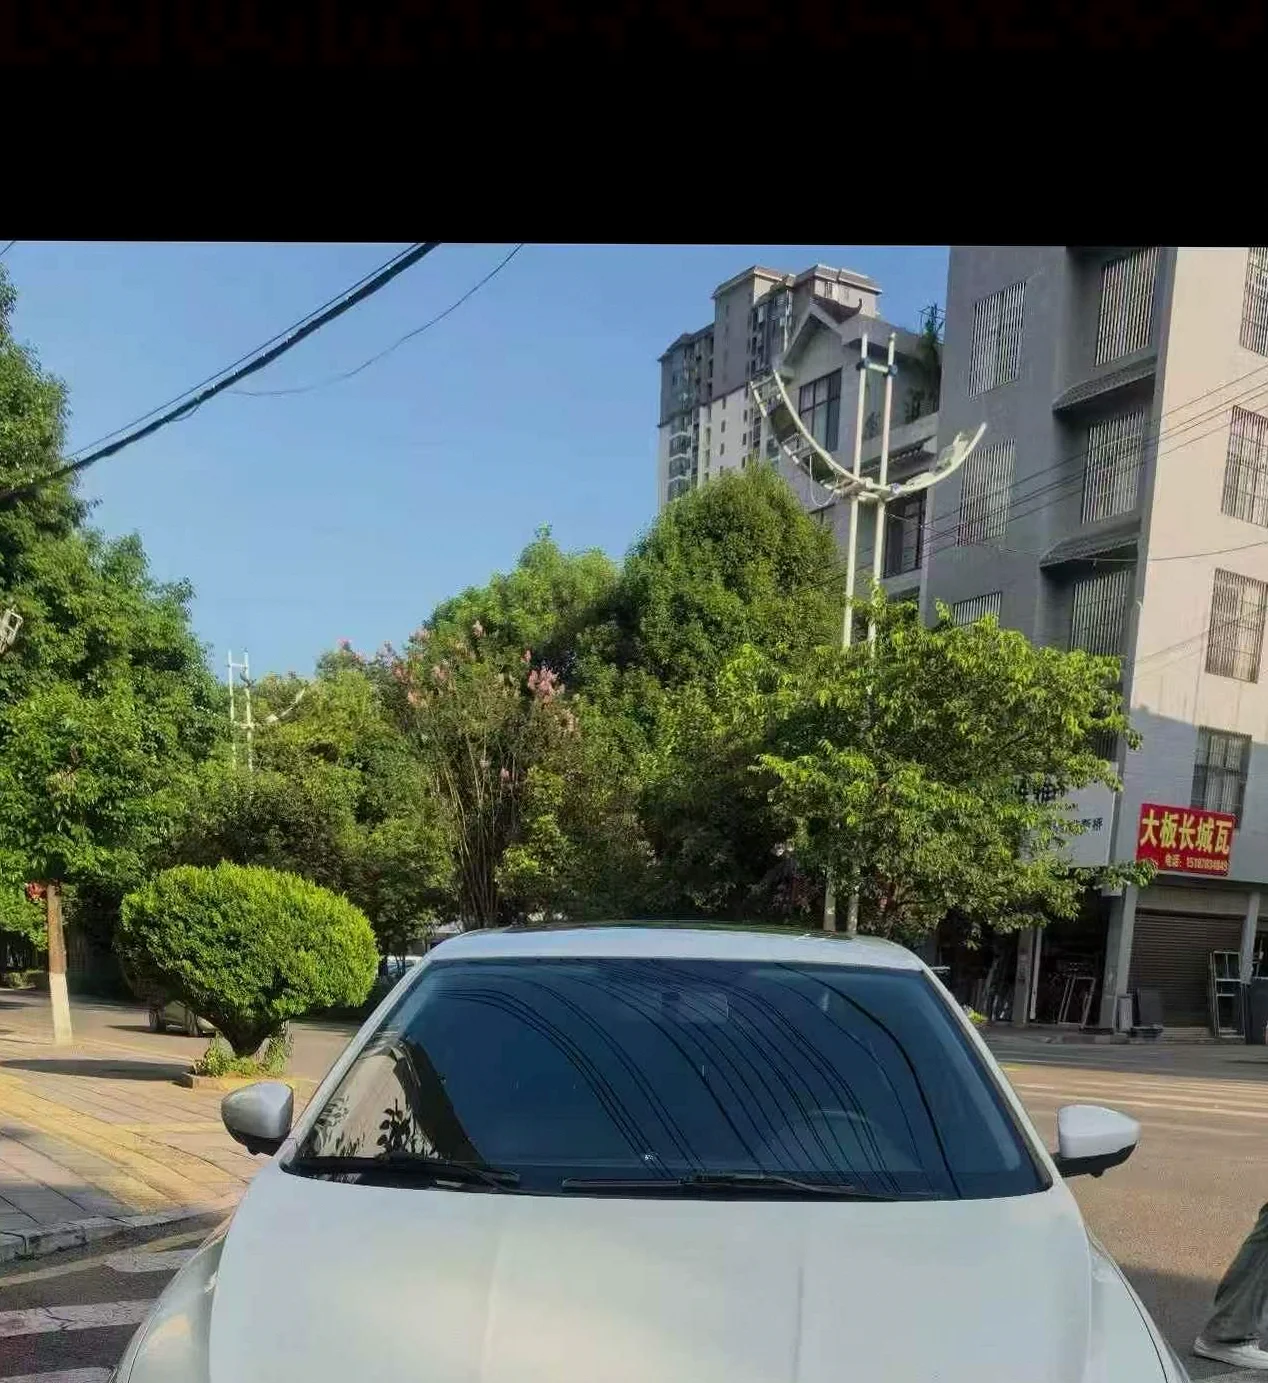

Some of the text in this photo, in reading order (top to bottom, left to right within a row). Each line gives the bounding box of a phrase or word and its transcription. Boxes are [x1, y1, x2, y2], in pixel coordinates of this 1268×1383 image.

[1140, 808, 1233, 855] 大板长城瓦
